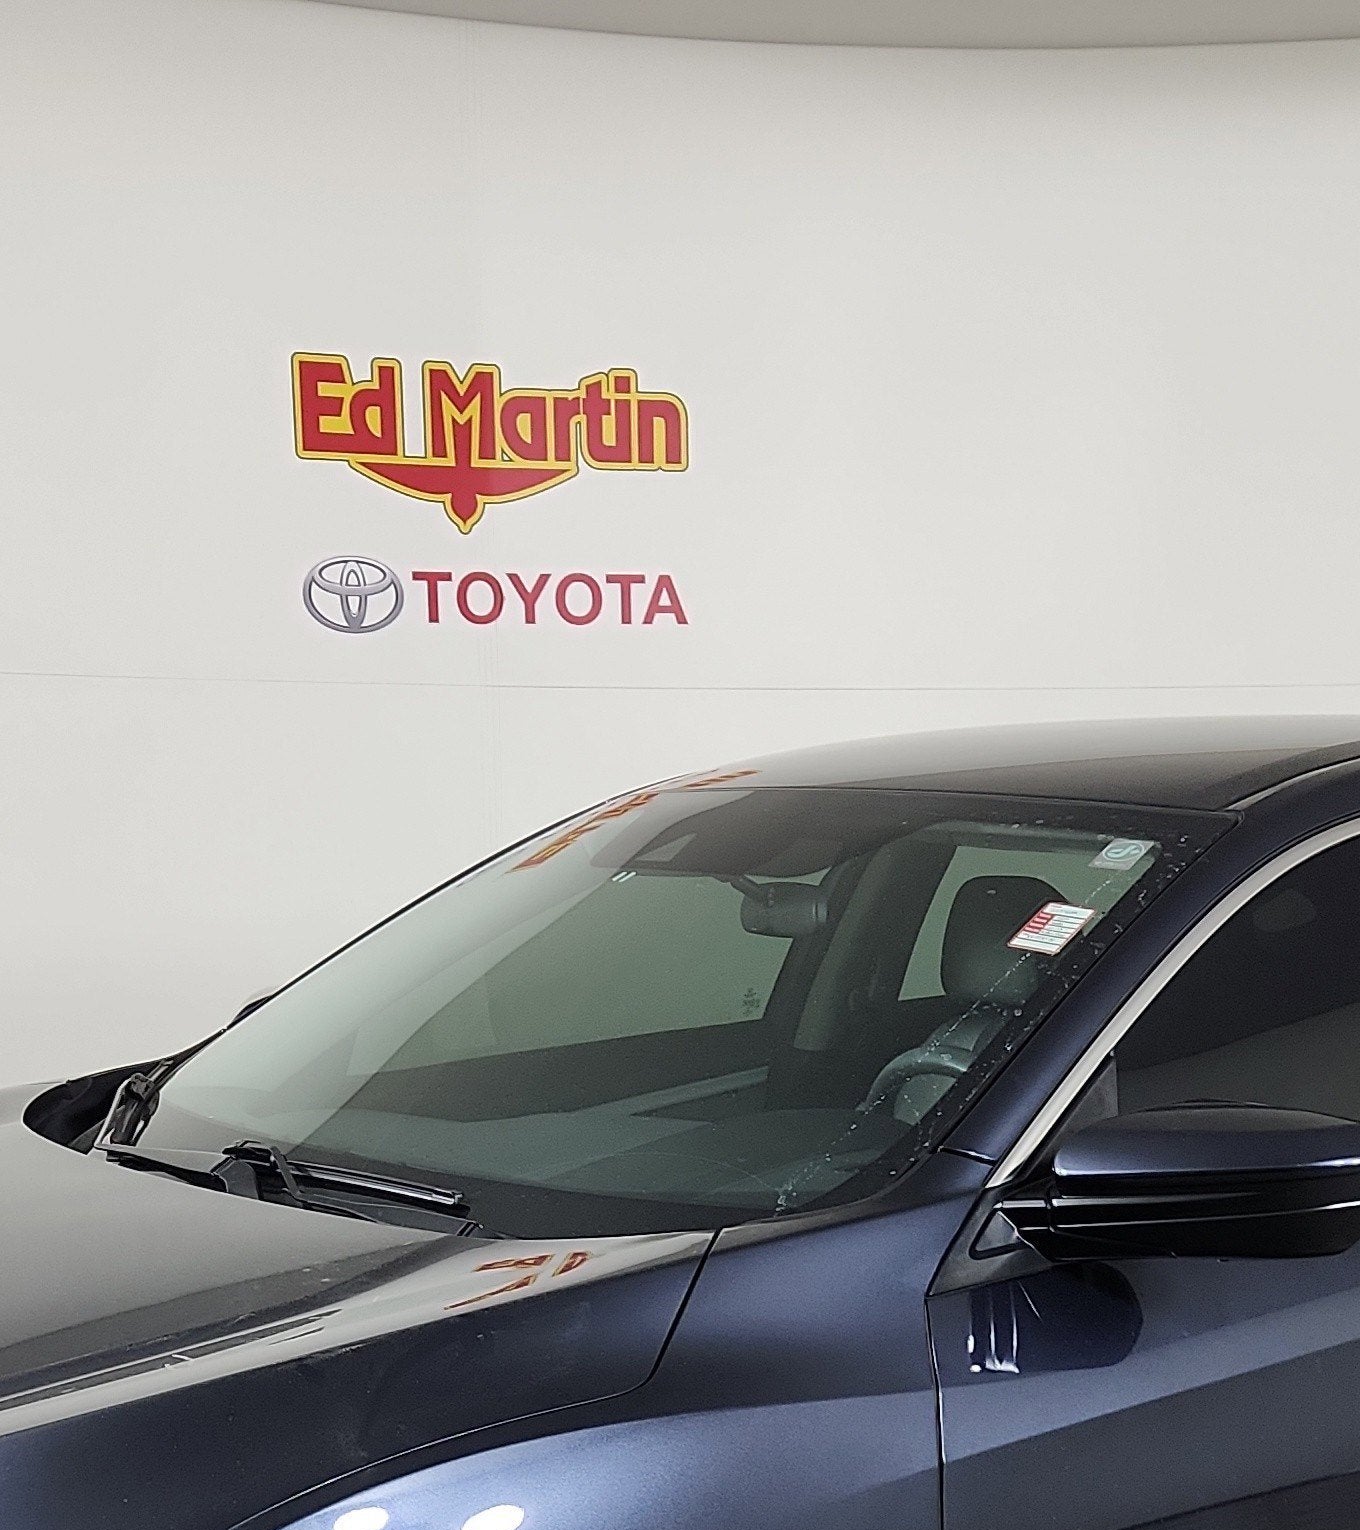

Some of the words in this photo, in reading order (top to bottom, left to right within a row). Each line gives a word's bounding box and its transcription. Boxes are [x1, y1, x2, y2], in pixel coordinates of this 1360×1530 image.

[295, 356, 400, 459] Ed
[424, 363, 686, 468] Martin
[412, 570, 688, 625] TOYOTA
